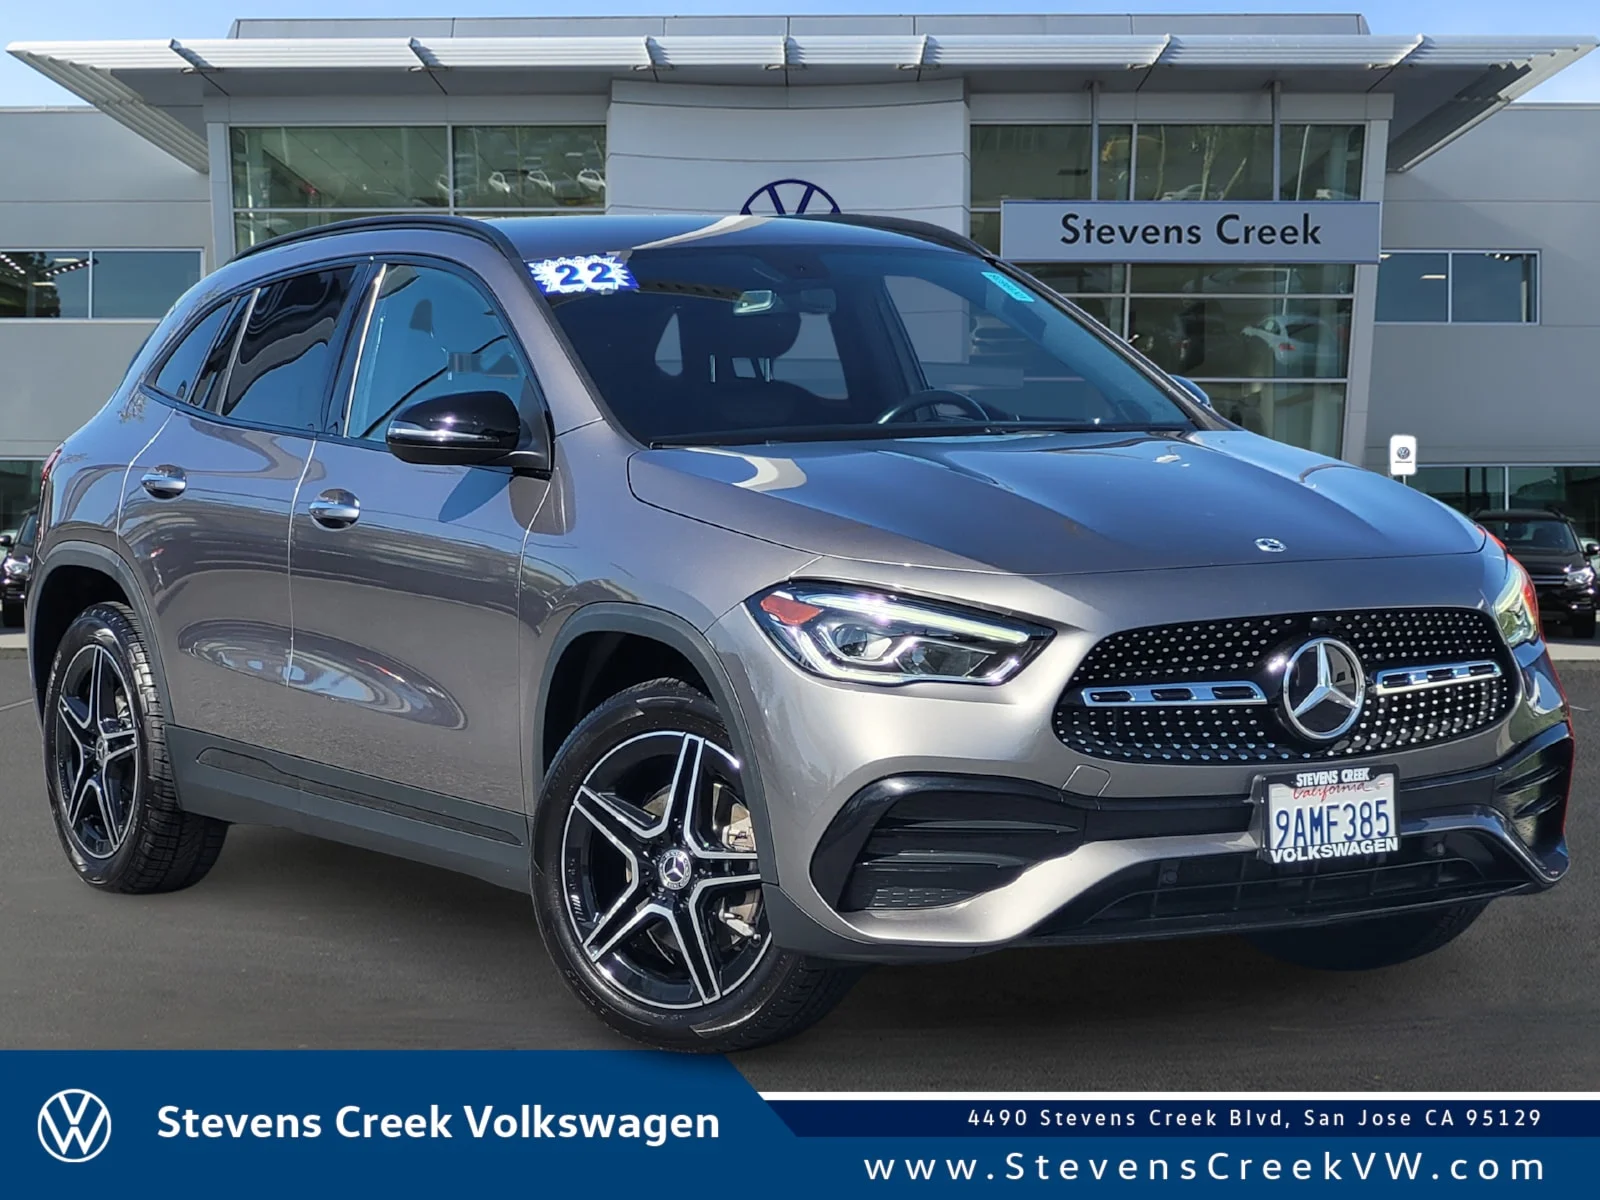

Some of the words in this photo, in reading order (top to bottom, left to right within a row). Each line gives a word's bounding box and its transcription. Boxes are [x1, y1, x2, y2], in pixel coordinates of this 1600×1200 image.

[1060, 213, 1202, 245] Stevens
[1216, 212, 1321, 245] Creek
[555, 262, 616, 286] 22
[1296, 770, 1338, 787] STEVENS
[1341, 767, 1370, 783] CREEK
[1275, 799, 1390, 850] 9AMF385
[1270, 837, 1399, 864] VOLKSWAGEN
